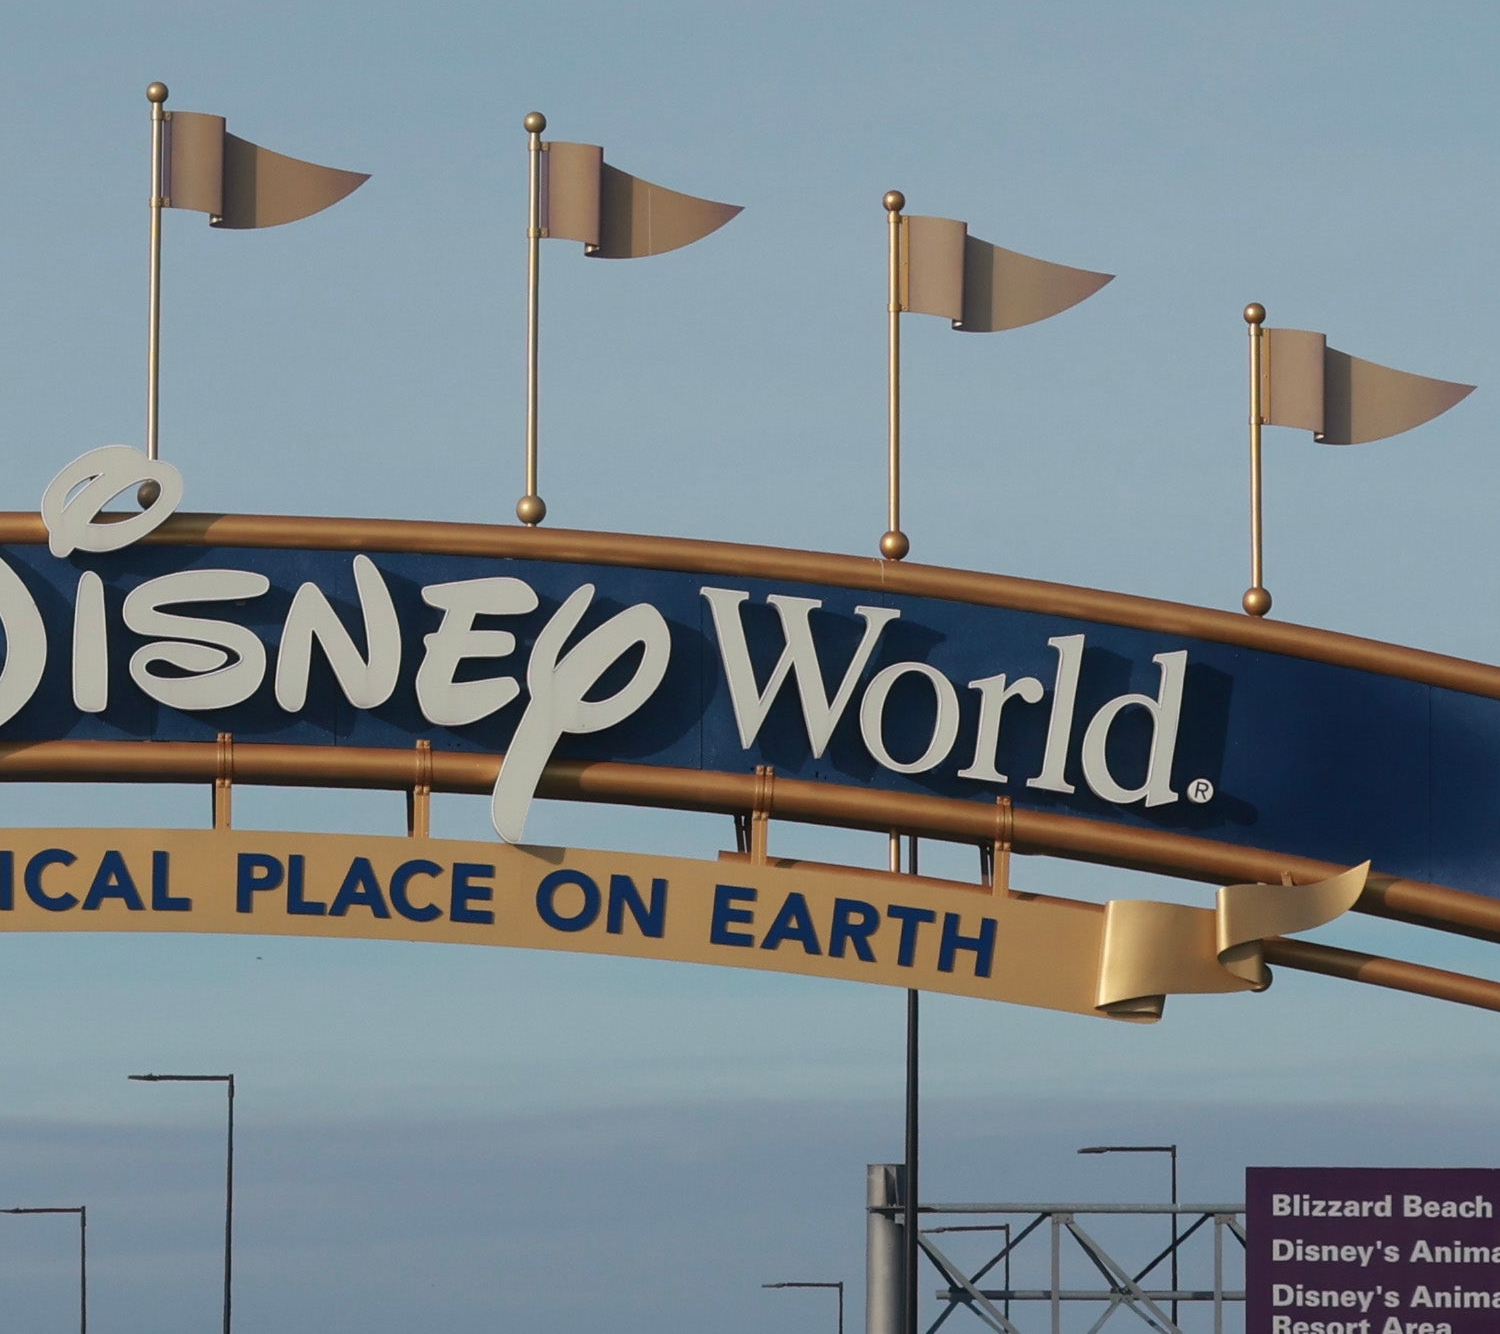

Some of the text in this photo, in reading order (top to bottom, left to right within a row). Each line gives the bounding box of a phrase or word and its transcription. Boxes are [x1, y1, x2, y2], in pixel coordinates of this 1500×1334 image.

[235, 851, 495, 926] PLACE
[535, 866, 669, 940] ON
[709, 887, 997, 979] EARTH
[1272, 1194, 1392, 1218] Blizzard
[1403, 1195, 1493, 1219] Beach
[1272, 1239, 1400, 1267] Disney's
[1272, 1284, 1400, 1312] Disney's
